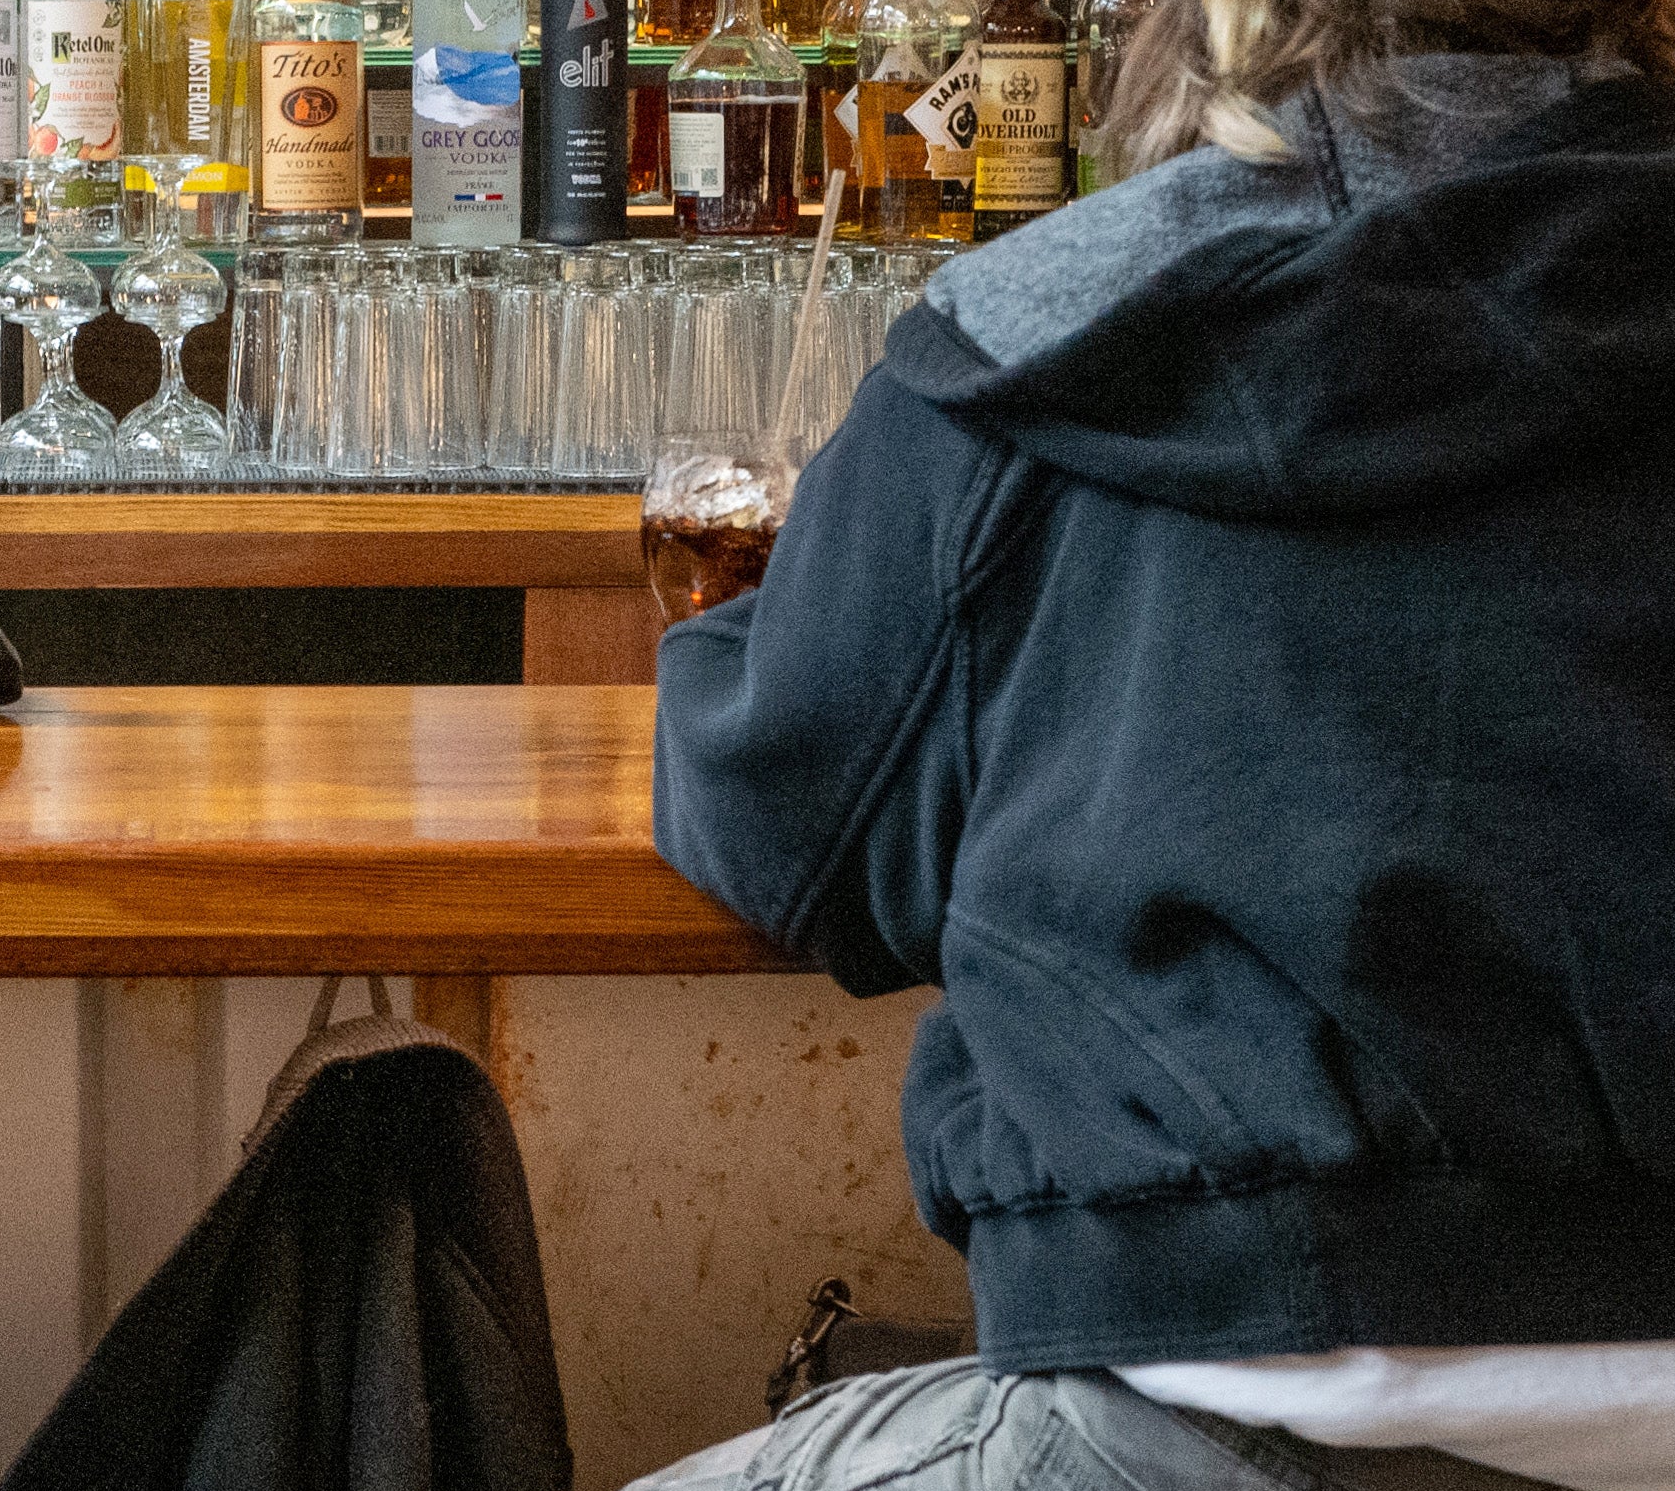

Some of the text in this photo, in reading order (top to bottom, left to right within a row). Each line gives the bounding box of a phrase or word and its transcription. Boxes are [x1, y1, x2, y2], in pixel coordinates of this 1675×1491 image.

[54, 35, 115, 59] Ketel One
[5, 57, 17, 77] On
[273, 51, 347, 79] Tito's
[560, 38, 615, 88] elit
[70, 80, 98, 90] PEACH
[188, 38, 211, 141] AMSTERDAM
[929, 72, 970, 112] RAM'S
[1002, 108, 1036, 123] OLD
[422, 130, 520, 148] GREY GOOS
[977, 124, 1058, 139] OVERHOLT
[287, 159, 336, 169] VODKA
[450, 152, 507, 164] VODKA
[184, 172, 223, 182] EMON
